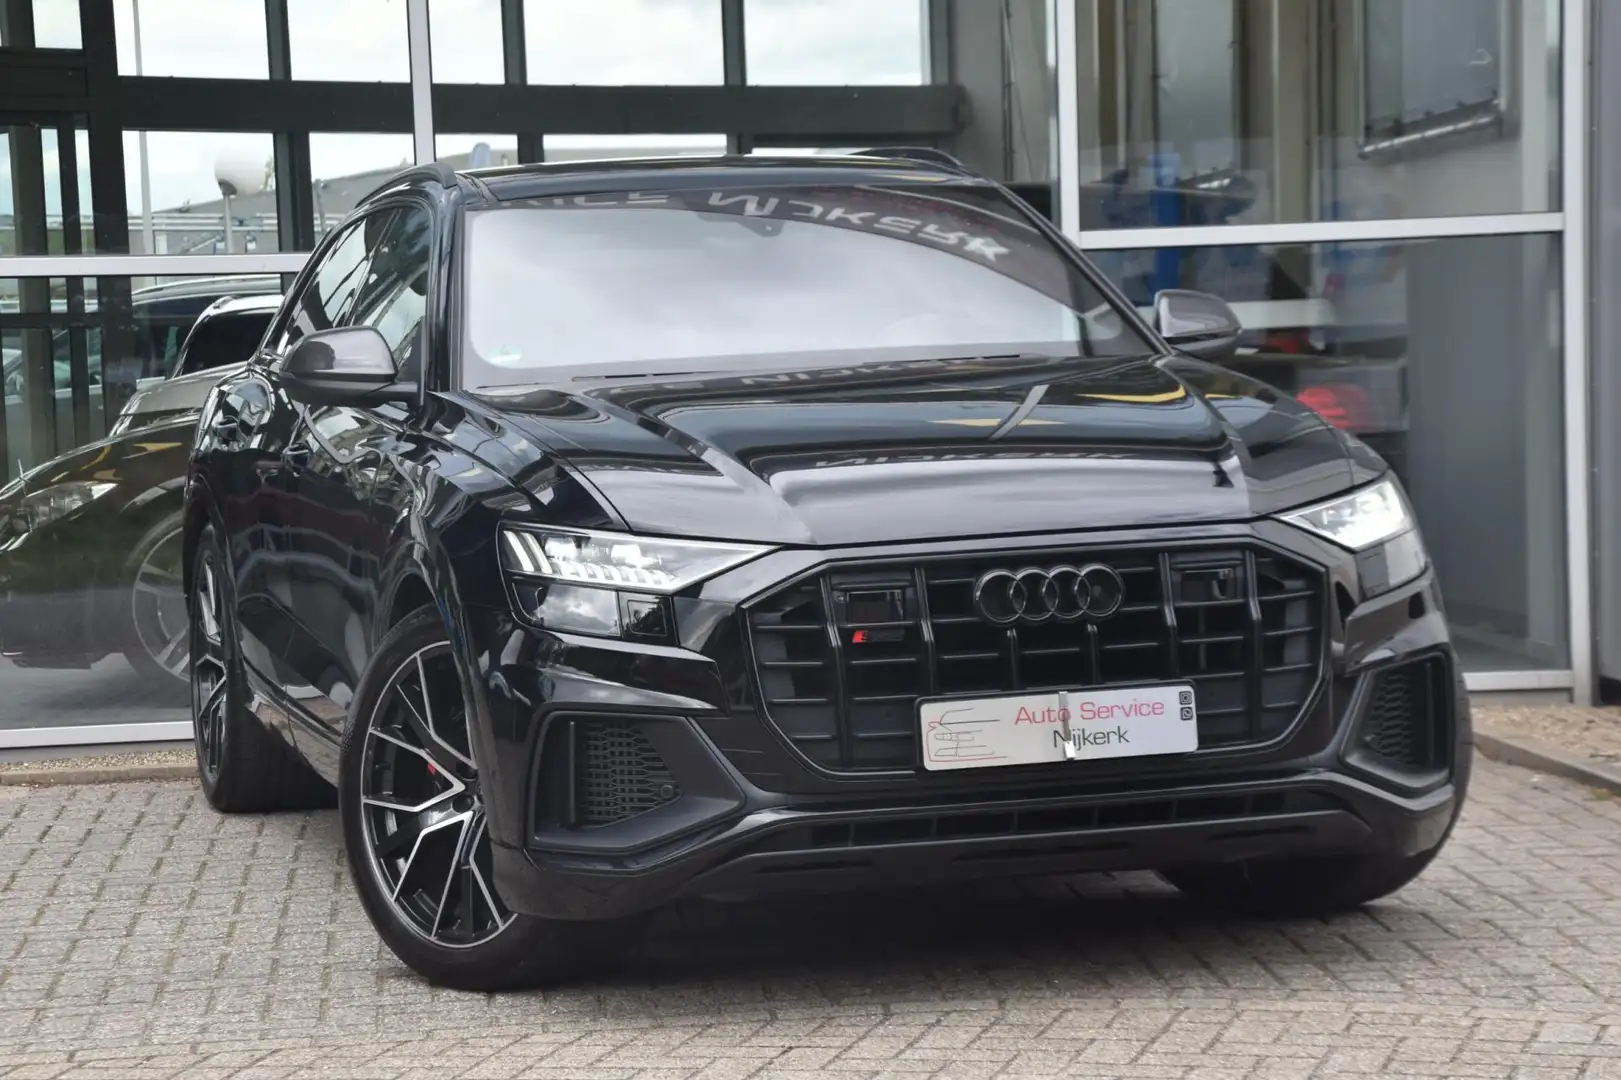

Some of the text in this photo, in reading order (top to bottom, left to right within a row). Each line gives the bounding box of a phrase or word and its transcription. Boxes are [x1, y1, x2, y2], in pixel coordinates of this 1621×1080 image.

[1015, 699, 1165, 725] Auto Service
[1053, 726, 1131, 751] Nijkerk
